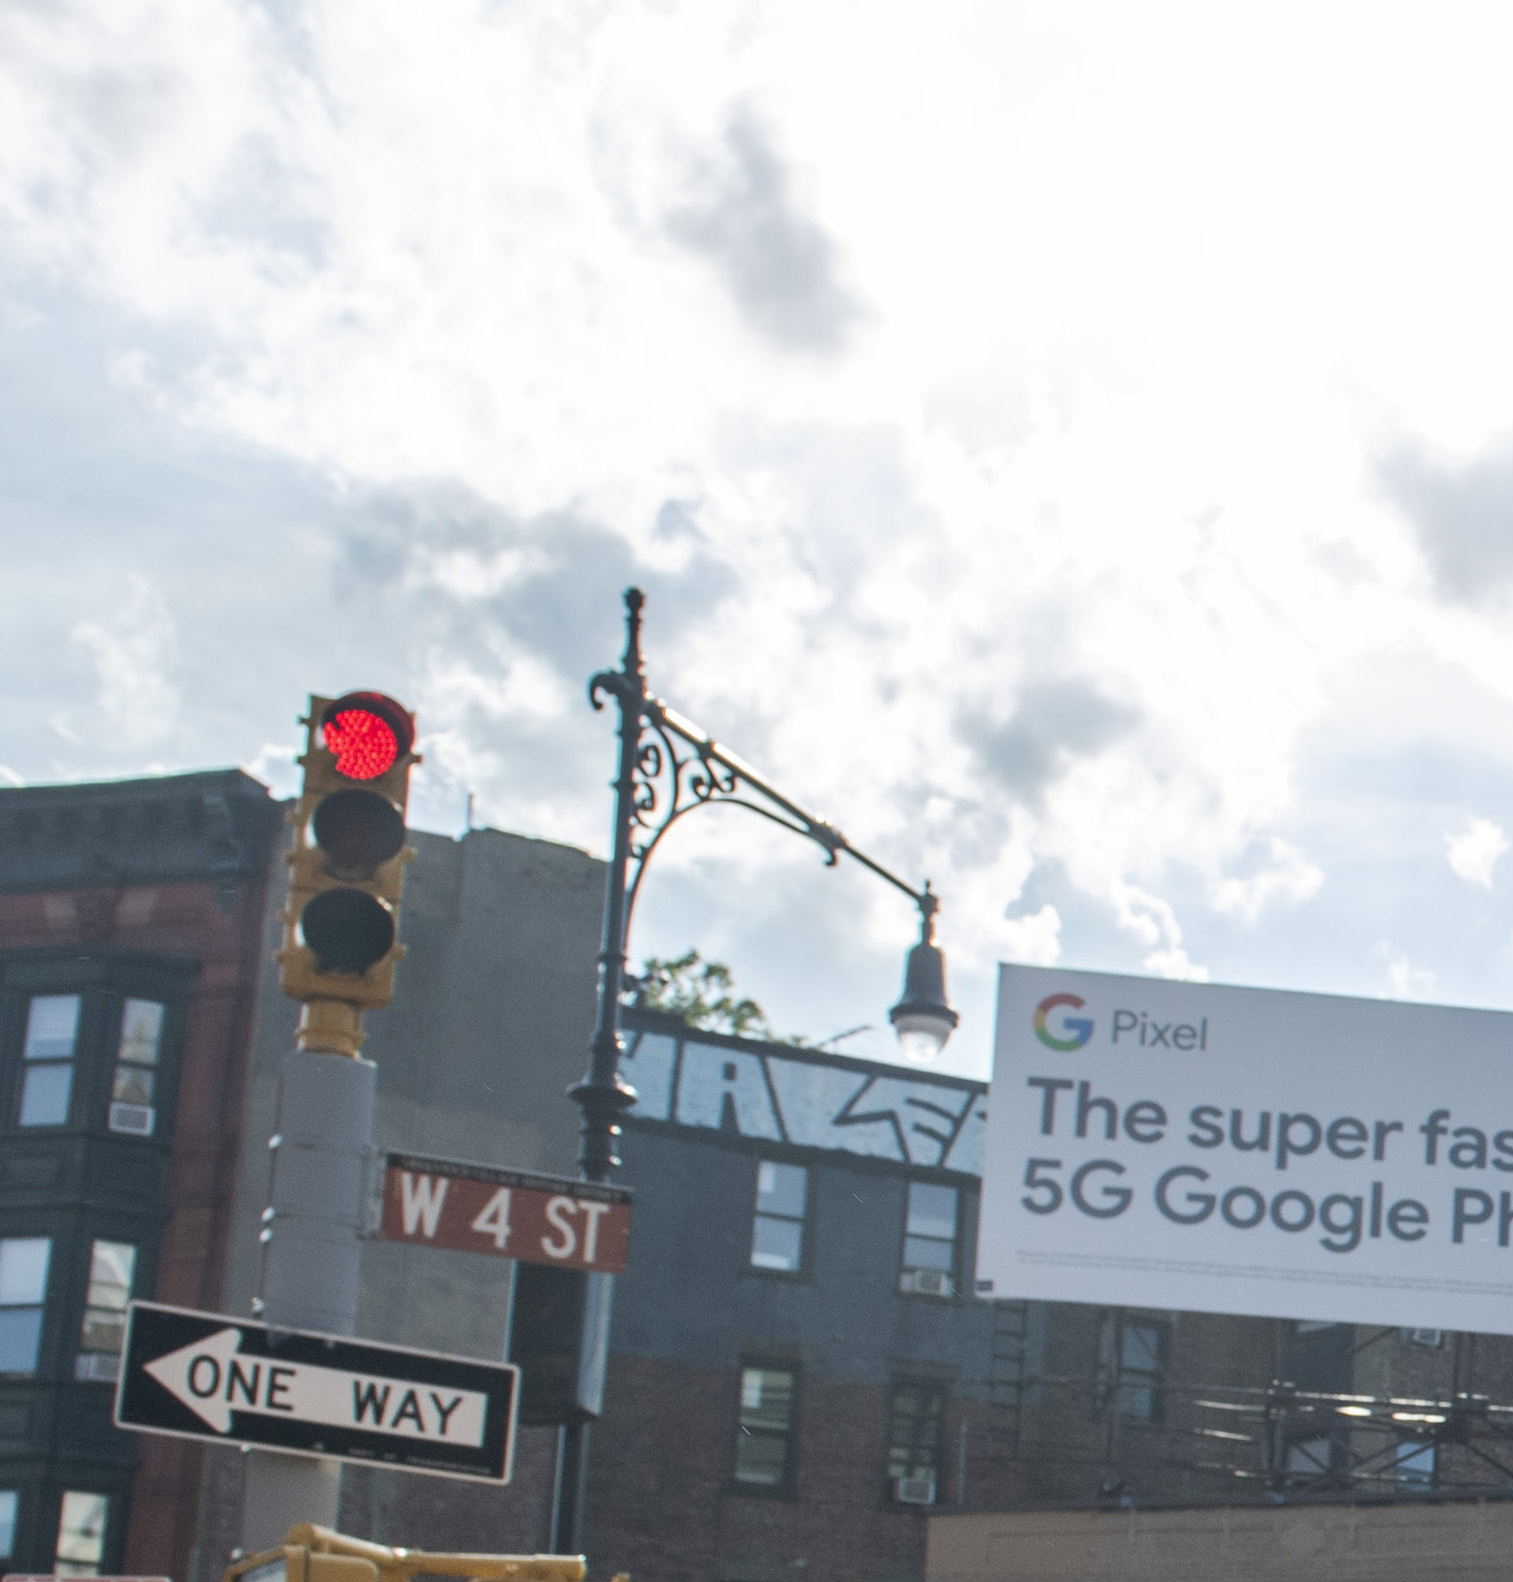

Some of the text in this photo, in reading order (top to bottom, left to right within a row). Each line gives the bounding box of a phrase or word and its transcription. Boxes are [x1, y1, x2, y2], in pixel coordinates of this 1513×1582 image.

[1112, 1009, 1208, 1052] Pixel
[1027, 1076, 1168, 1144] The
[1187, 1105, 1403, 1170] super
[402, 1171, 449, 1240] W
[471, 1187, 512, 1250] 4
[541, 1196, 610, 1263] ST
[1021, 1157, 1133, 1219] 5G
[1155, 1165, 1430, 1253] Google
[187, 1354, 464, 1436] ONE WAY
